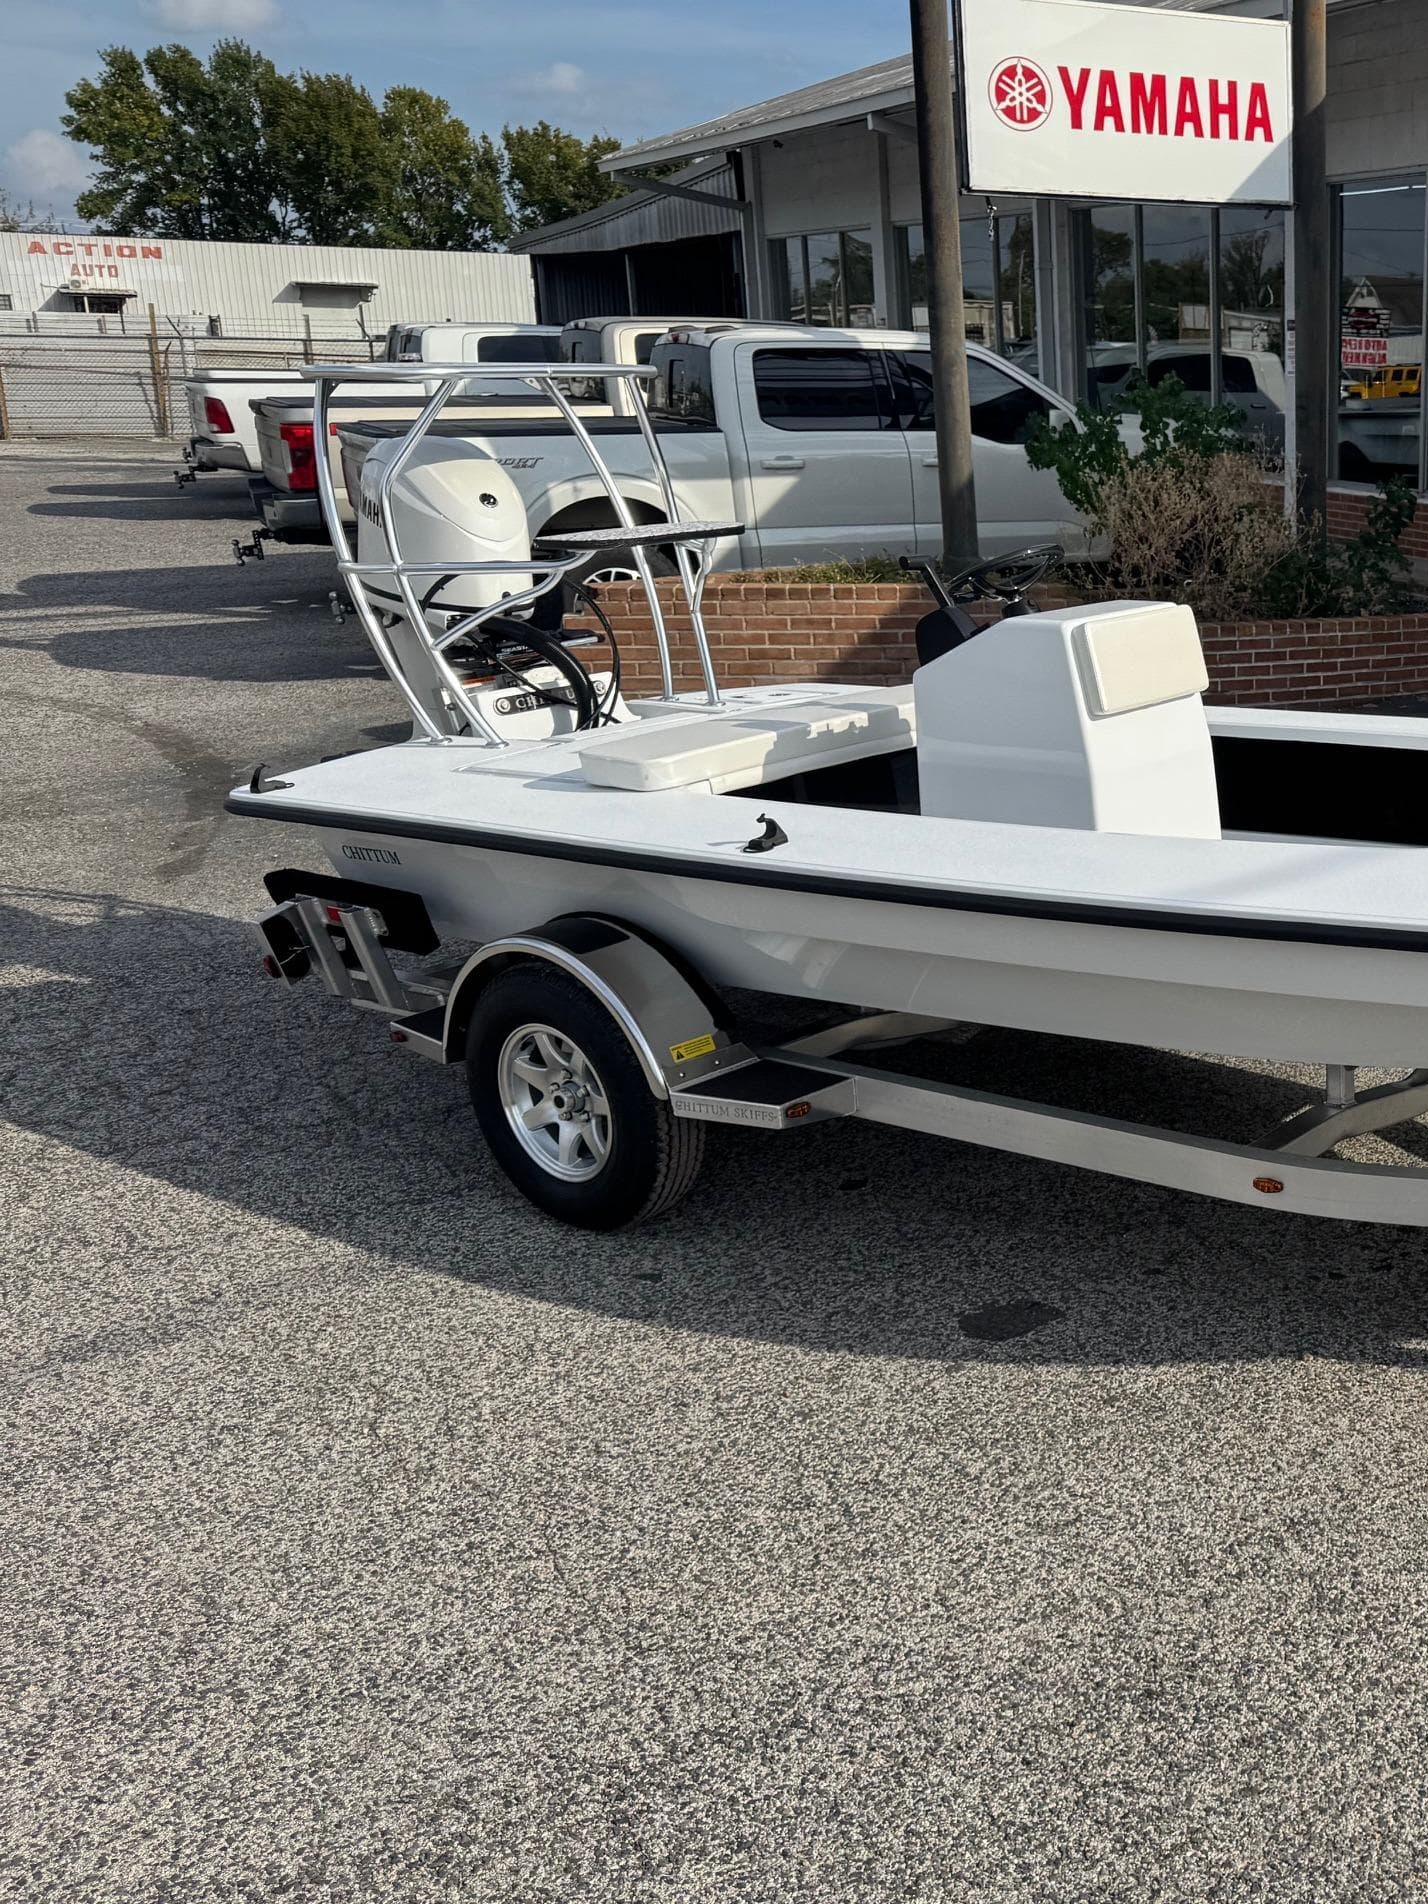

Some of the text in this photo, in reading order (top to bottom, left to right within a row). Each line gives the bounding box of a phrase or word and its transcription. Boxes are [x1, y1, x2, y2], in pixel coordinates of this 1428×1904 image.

[1056, 65, 1274, 143] YAMAHA
[27, 241, 163, 259] ACTION
[70, 263, 119, 278] AUTO
[342, 845, 401, 865] CHITTUM
[675, 1101, 774, 1121] CHITTUM SKIFFS
